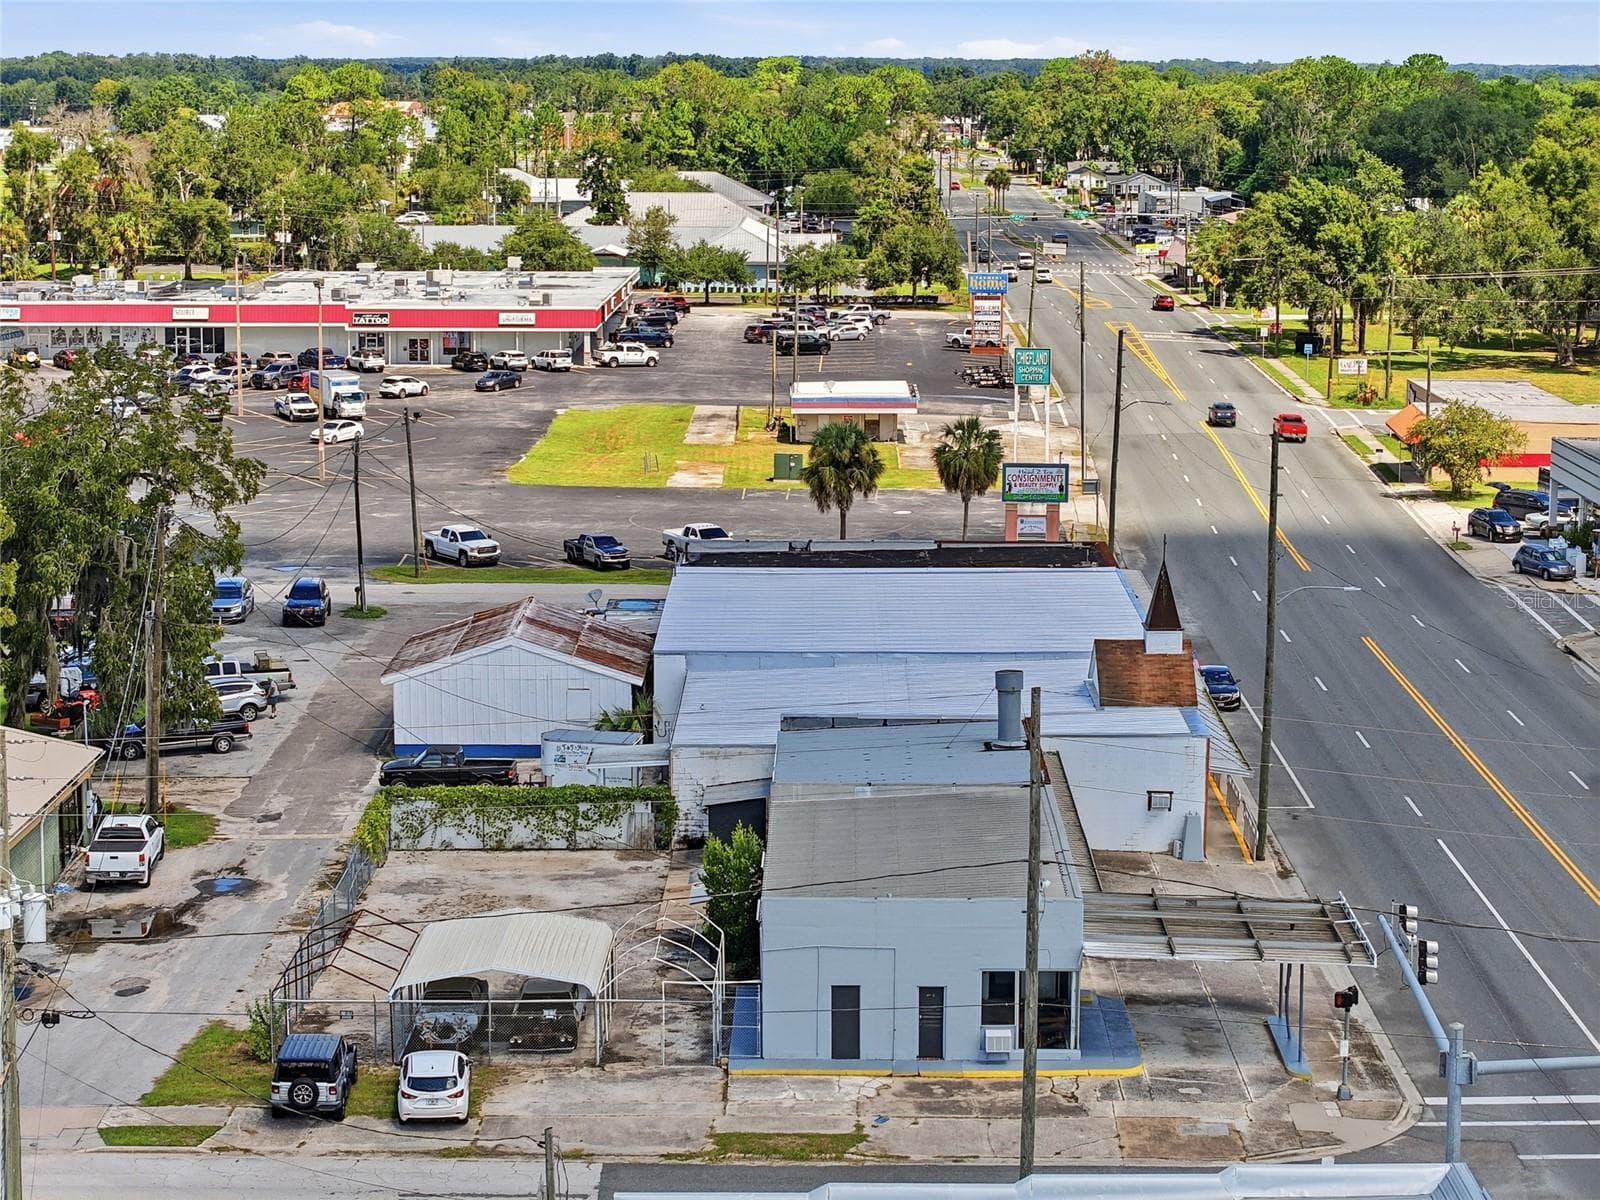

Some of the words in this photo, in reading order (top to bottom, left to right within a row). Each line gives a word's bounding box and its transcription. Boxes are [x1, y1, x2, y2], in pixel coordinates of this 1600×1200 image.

[970, 280, 1006, 288] home
[1016, 351, 1048, 365] CHIEFLAND
[1018, 366, 1046, 374] SHOPPING
